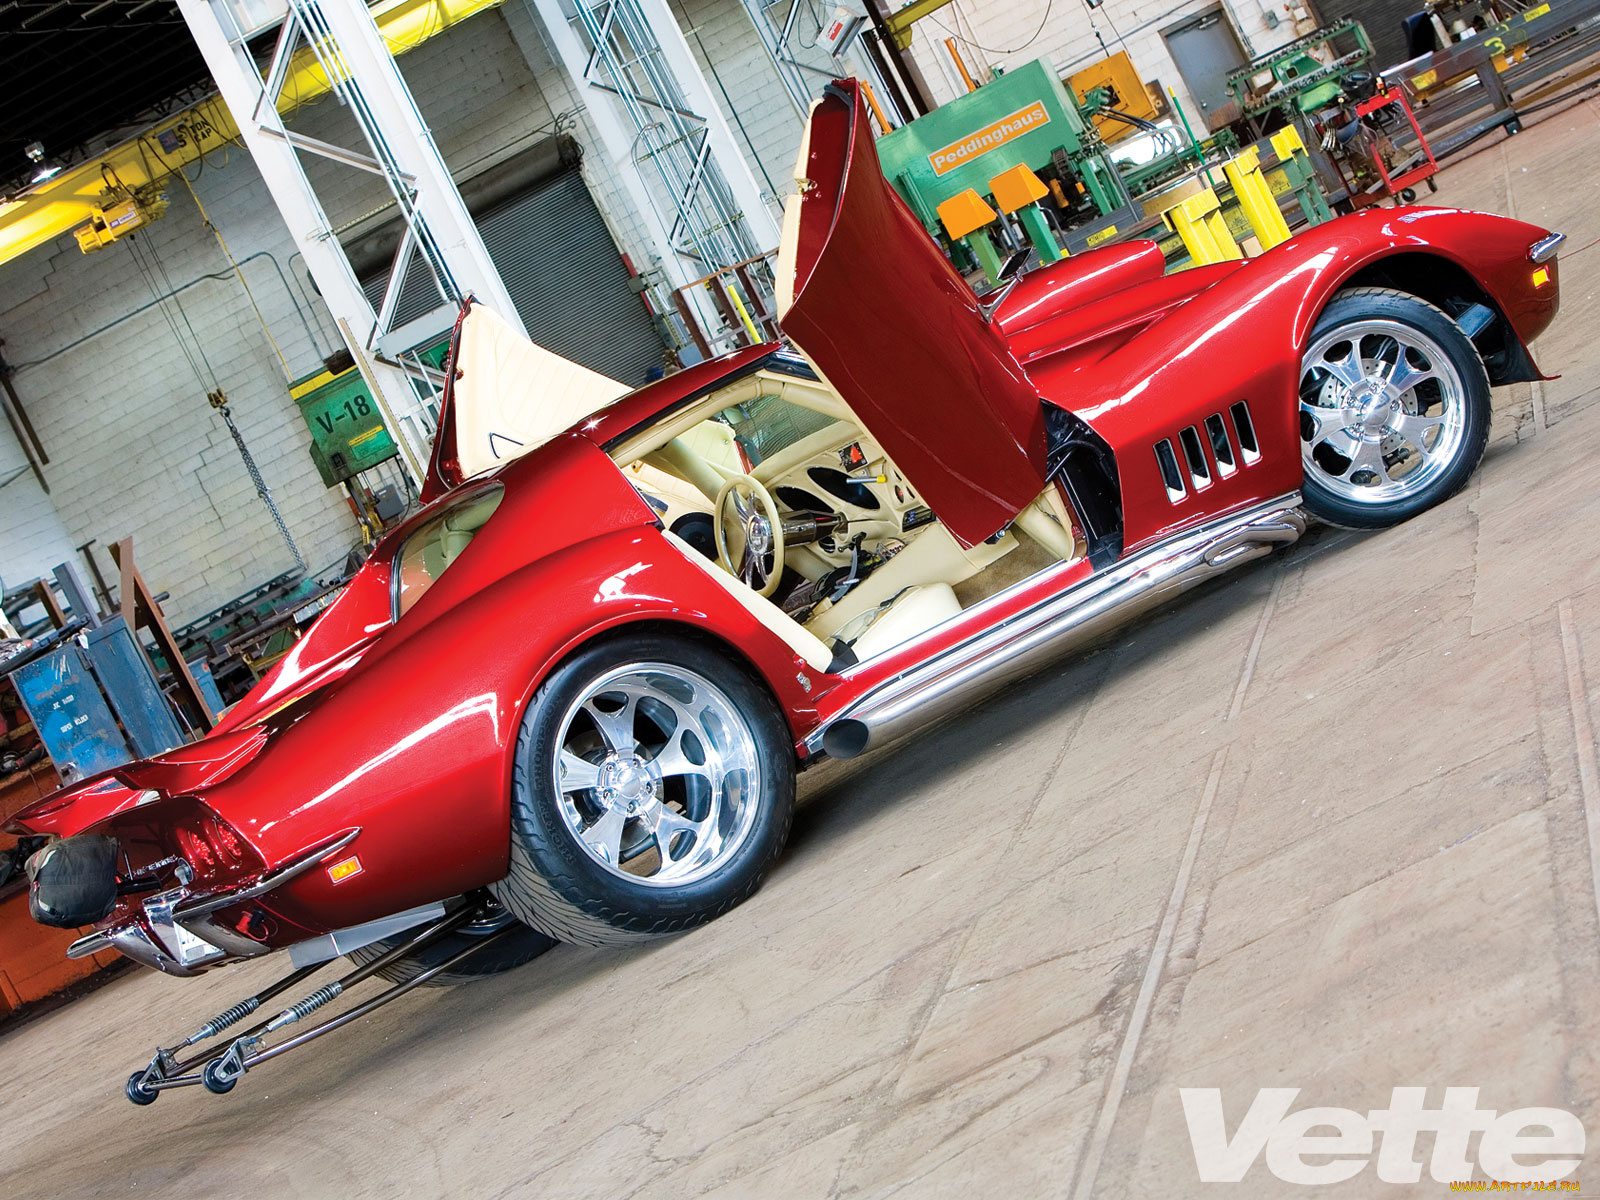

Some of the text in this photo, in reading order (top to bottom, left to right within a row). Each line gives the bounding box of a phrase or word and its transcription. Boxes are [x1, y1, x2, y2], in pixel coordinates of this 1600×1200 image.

[934, 109, 1044, 168] Peddinghaus
[315, 395, 371, 434] V-18
[533, 695, 562, 791] THOMPSON
